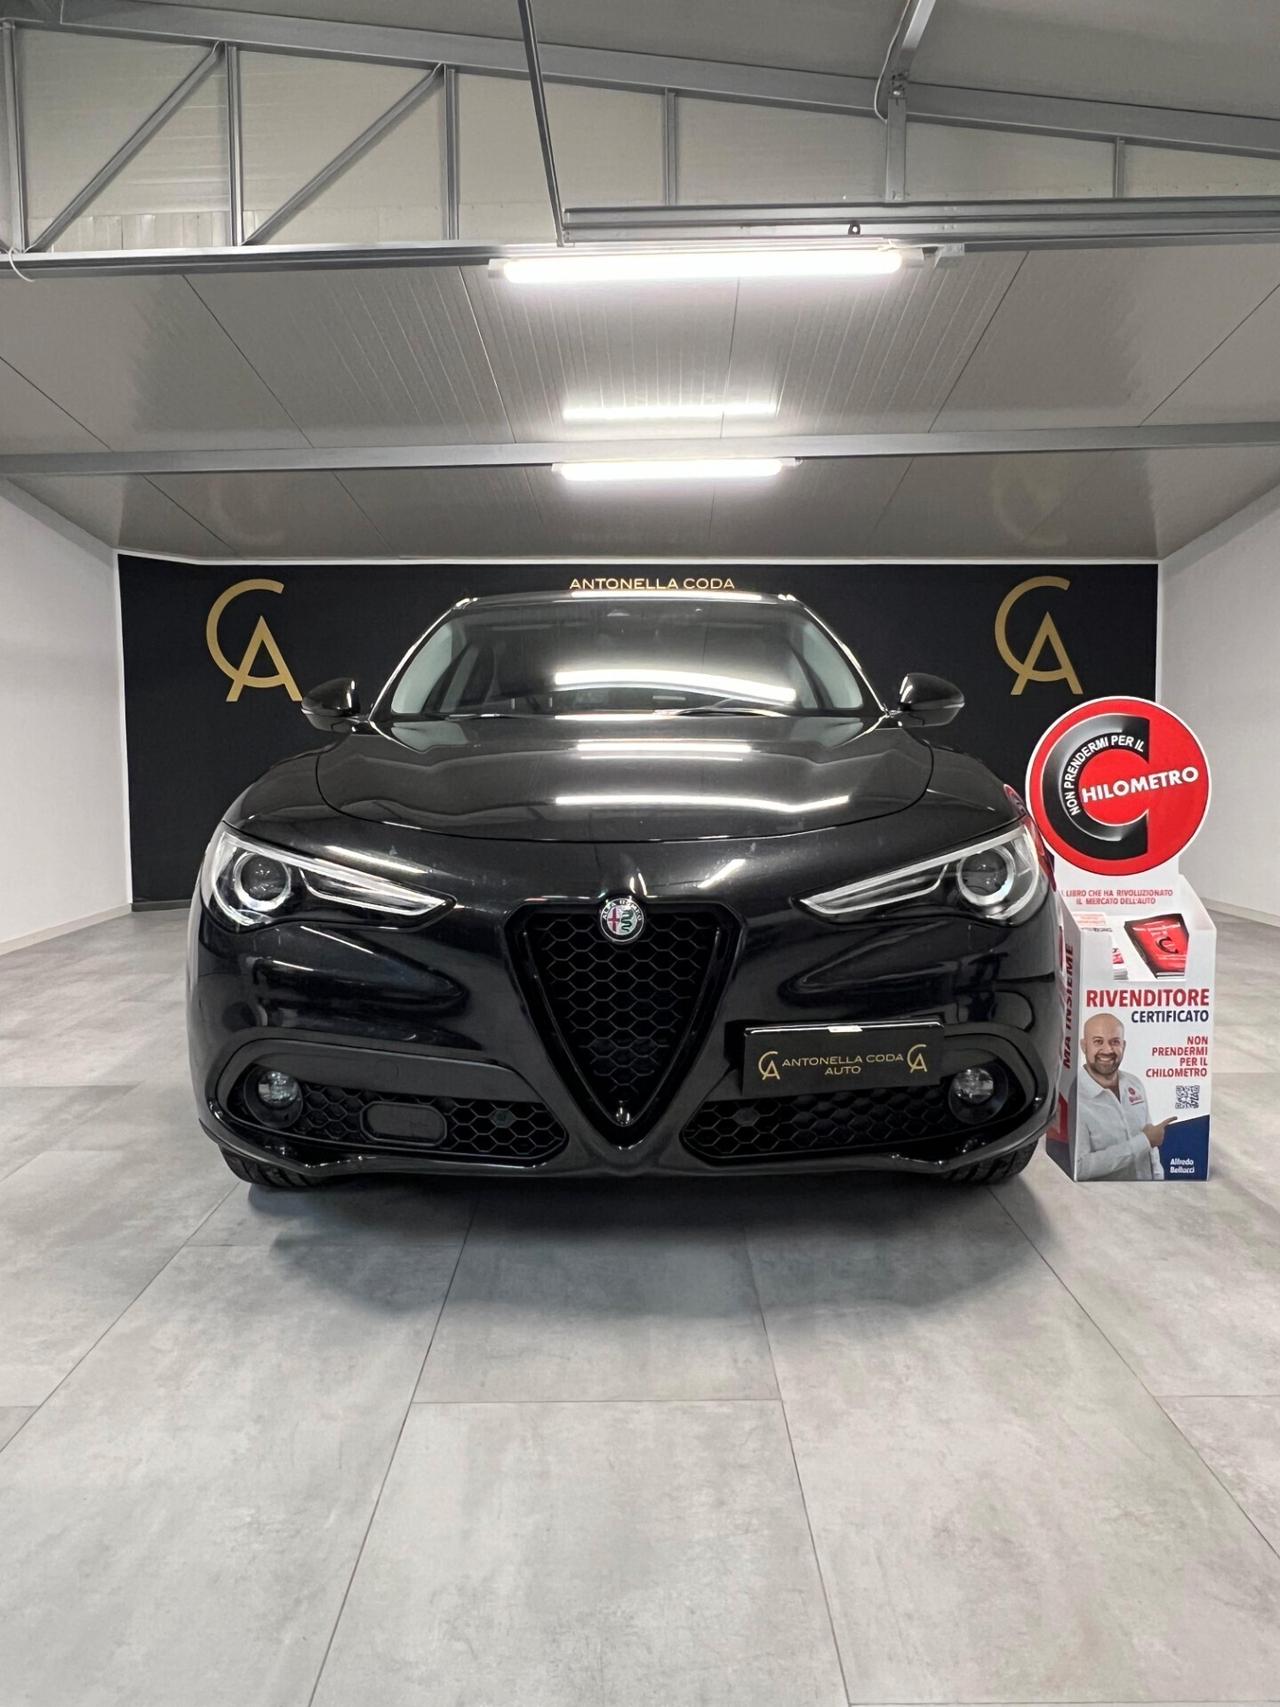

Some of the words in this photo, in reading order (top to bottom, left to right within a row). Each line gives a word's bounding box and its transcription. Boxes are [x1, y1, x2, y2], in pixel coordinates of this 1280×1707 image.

[569, 577, 679, 590] ANTONELLA
[683, 577, 735, 590] CODA
[1111, 735, 1134, 747] PER
[1134, 739, 1145, 752] IL
[1063, 736, 1110, 789] PRENDERMI
[1064, 792, 1081, 816] NON
[1066, 889, 1087, 897] LIBRO
[1088, 889, 1102, 897] CHE
[1103, 889, 1114, 897] HA
[1116, 889, 1174, 897] RIVOLUZIONATO
[1086, 988, 1210, 1008] RIVENDITORE
[1131, 1010, 1210, 1024] CERTIFICATO
[1187, 1035, 1208, 1046] NON
[1151, 1046, 1208, 1056] PRENDERMI
[782, 1055, 863, 1067] ANTONELLA
[865, 1053, 904, 1064] CODA
[1179, 1057, 1198, 1067] PER
[1199, 1057, 1208, 1067] IL
[824, 1065, 862, 1076] AUTO
[1145, 1068, 1208, 1078] CHILOMETRO
